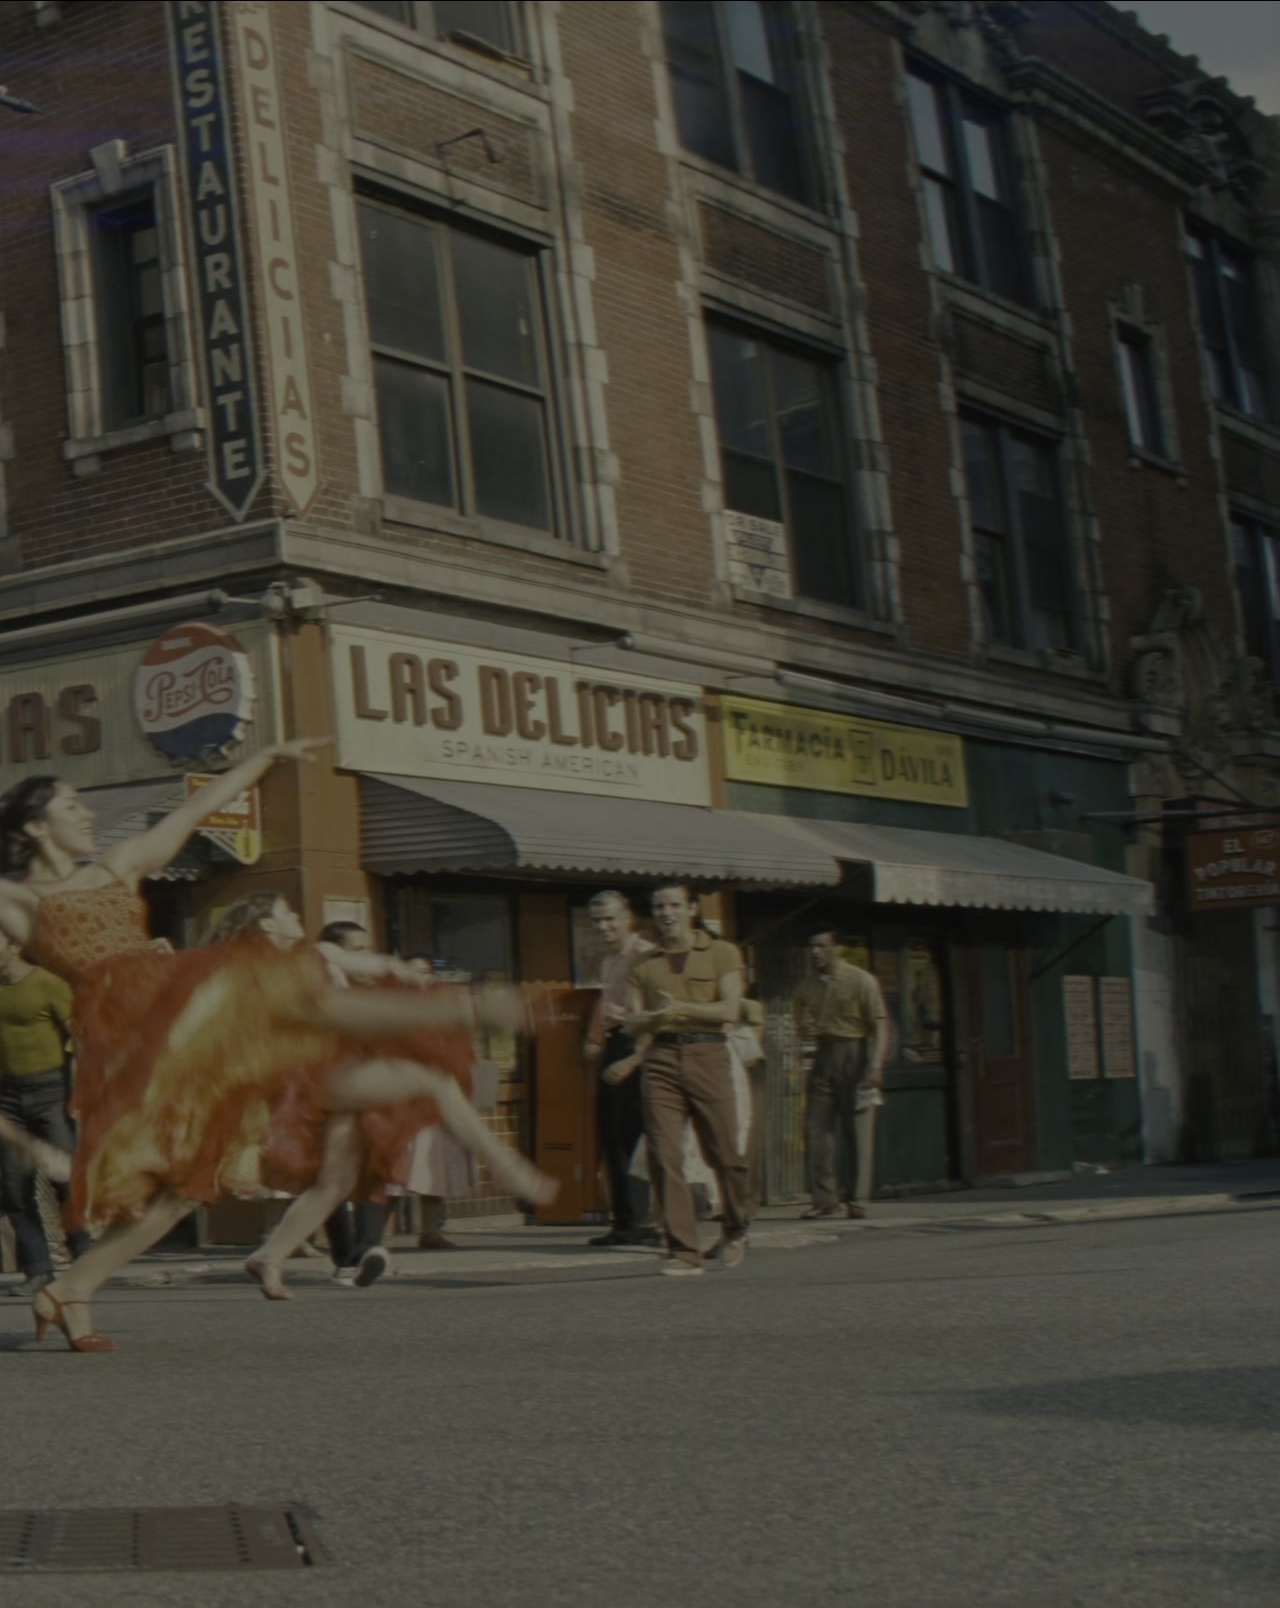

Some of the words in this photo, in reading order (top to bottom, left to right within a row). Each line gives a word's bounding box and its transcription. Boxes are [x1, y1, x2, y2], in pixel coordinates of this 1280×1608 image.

[243, 25, 311, 479] DELICIAS
[349, 644, 464, 732] LAS
[477, 664, 699, 762] DELICIAS
[441, 740, 532, 767] SPANISH
[542, 750, 639, 780] AMERICAN
